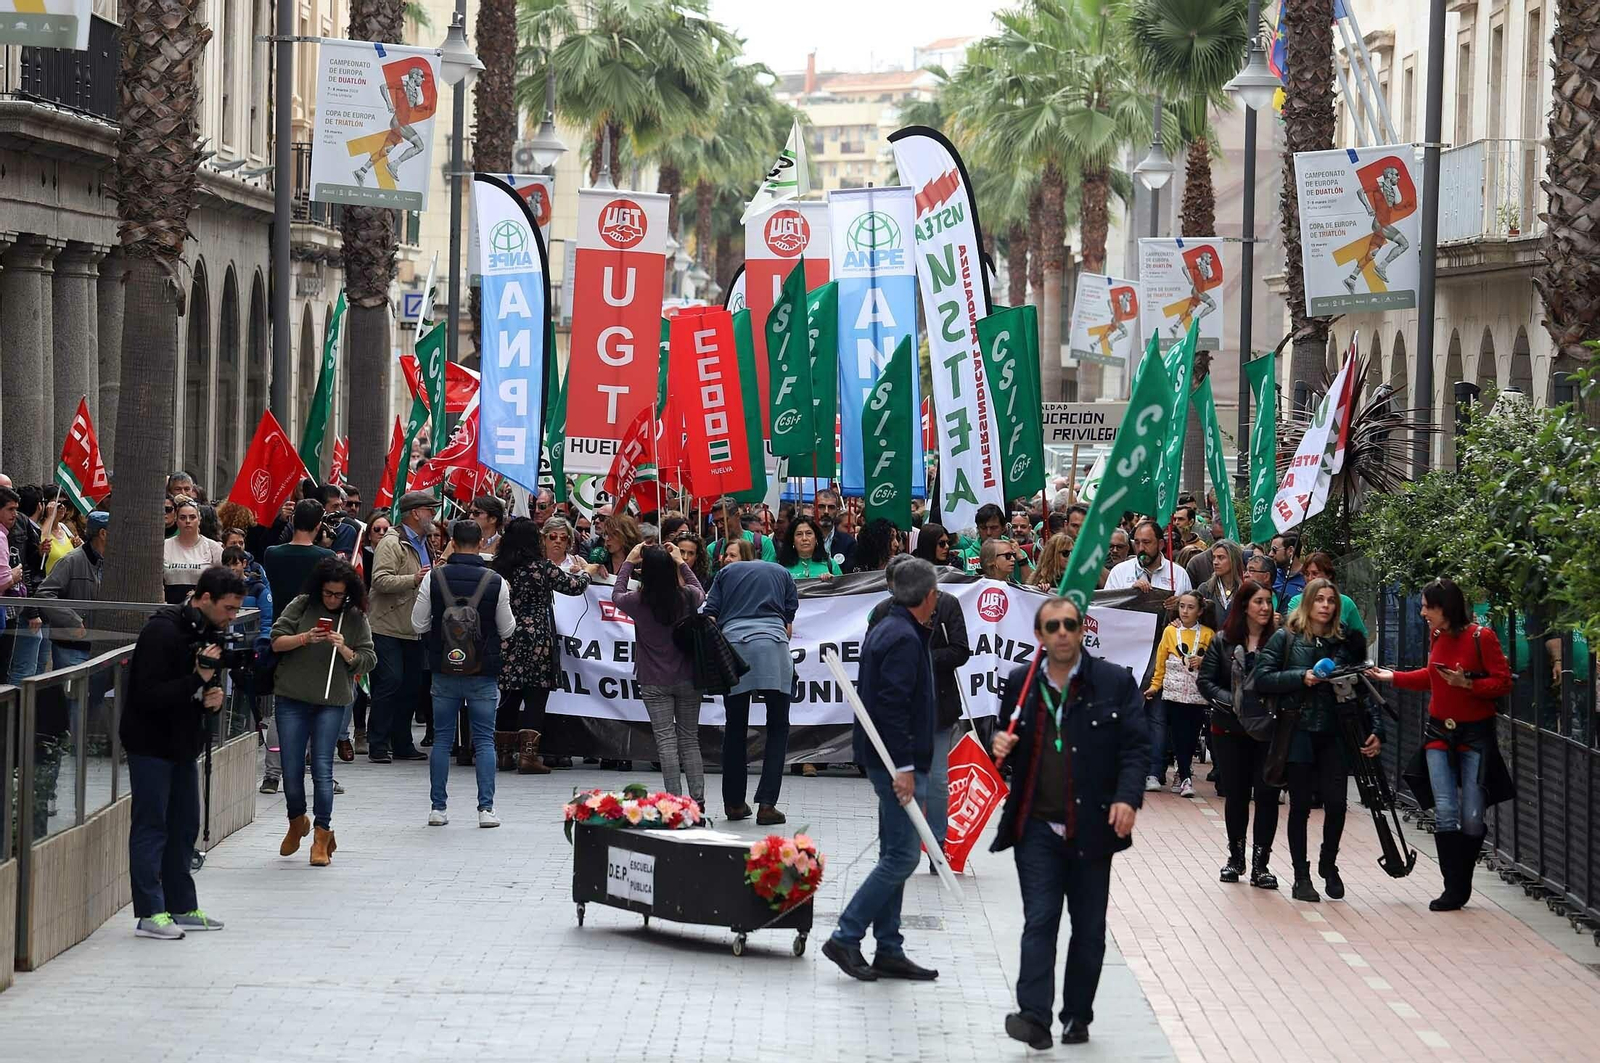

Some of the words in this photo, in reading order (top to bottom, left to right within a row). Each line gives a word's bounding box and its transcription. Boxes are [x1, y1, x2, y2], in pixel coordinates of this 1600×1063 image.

[329, 58, 371, 68] CAMPEONATO
[339, 68, 363, 76] EUROPA
[338, 76, 367, 85] DUATLÓN
[325, 109, 341, 117] COPA
[342, 110, 351, 118] DE
[352, 112, 376, 120] EUROPA
[335, 118, 364, 127] TRIATLÓN
[1304, 169, 1345, 179] CAMPEONATO
[1315, 179, 1339, 187] EUROPA
[1315, 187, 1344, 196] DUATLÓN
[604, 207, 642, 228] UGT
[770, 217, 805, 237] UGT
[1326, 221, 1334, 229] DE
[1334, 220, 1357, 228] EUROPA
[1309, 231, 1318, 239] DE
[1319, 229, 1347, 239] TRIATLÓN
[843, 249, 905, 268] ANPE
[597, 266, 637, 425] UGT
[693, 328, 729, 436] CCOO
[1052, 427, 1120, 441] PRIVILEGI
[711, 466, 734, 475] HUELVA
[981, 592, 1006, 613] UGT
[819, 641, 860, 664] DE
[948, 774, 993, 839] UGT
[630, 860, 653, 874] ESCUELA
